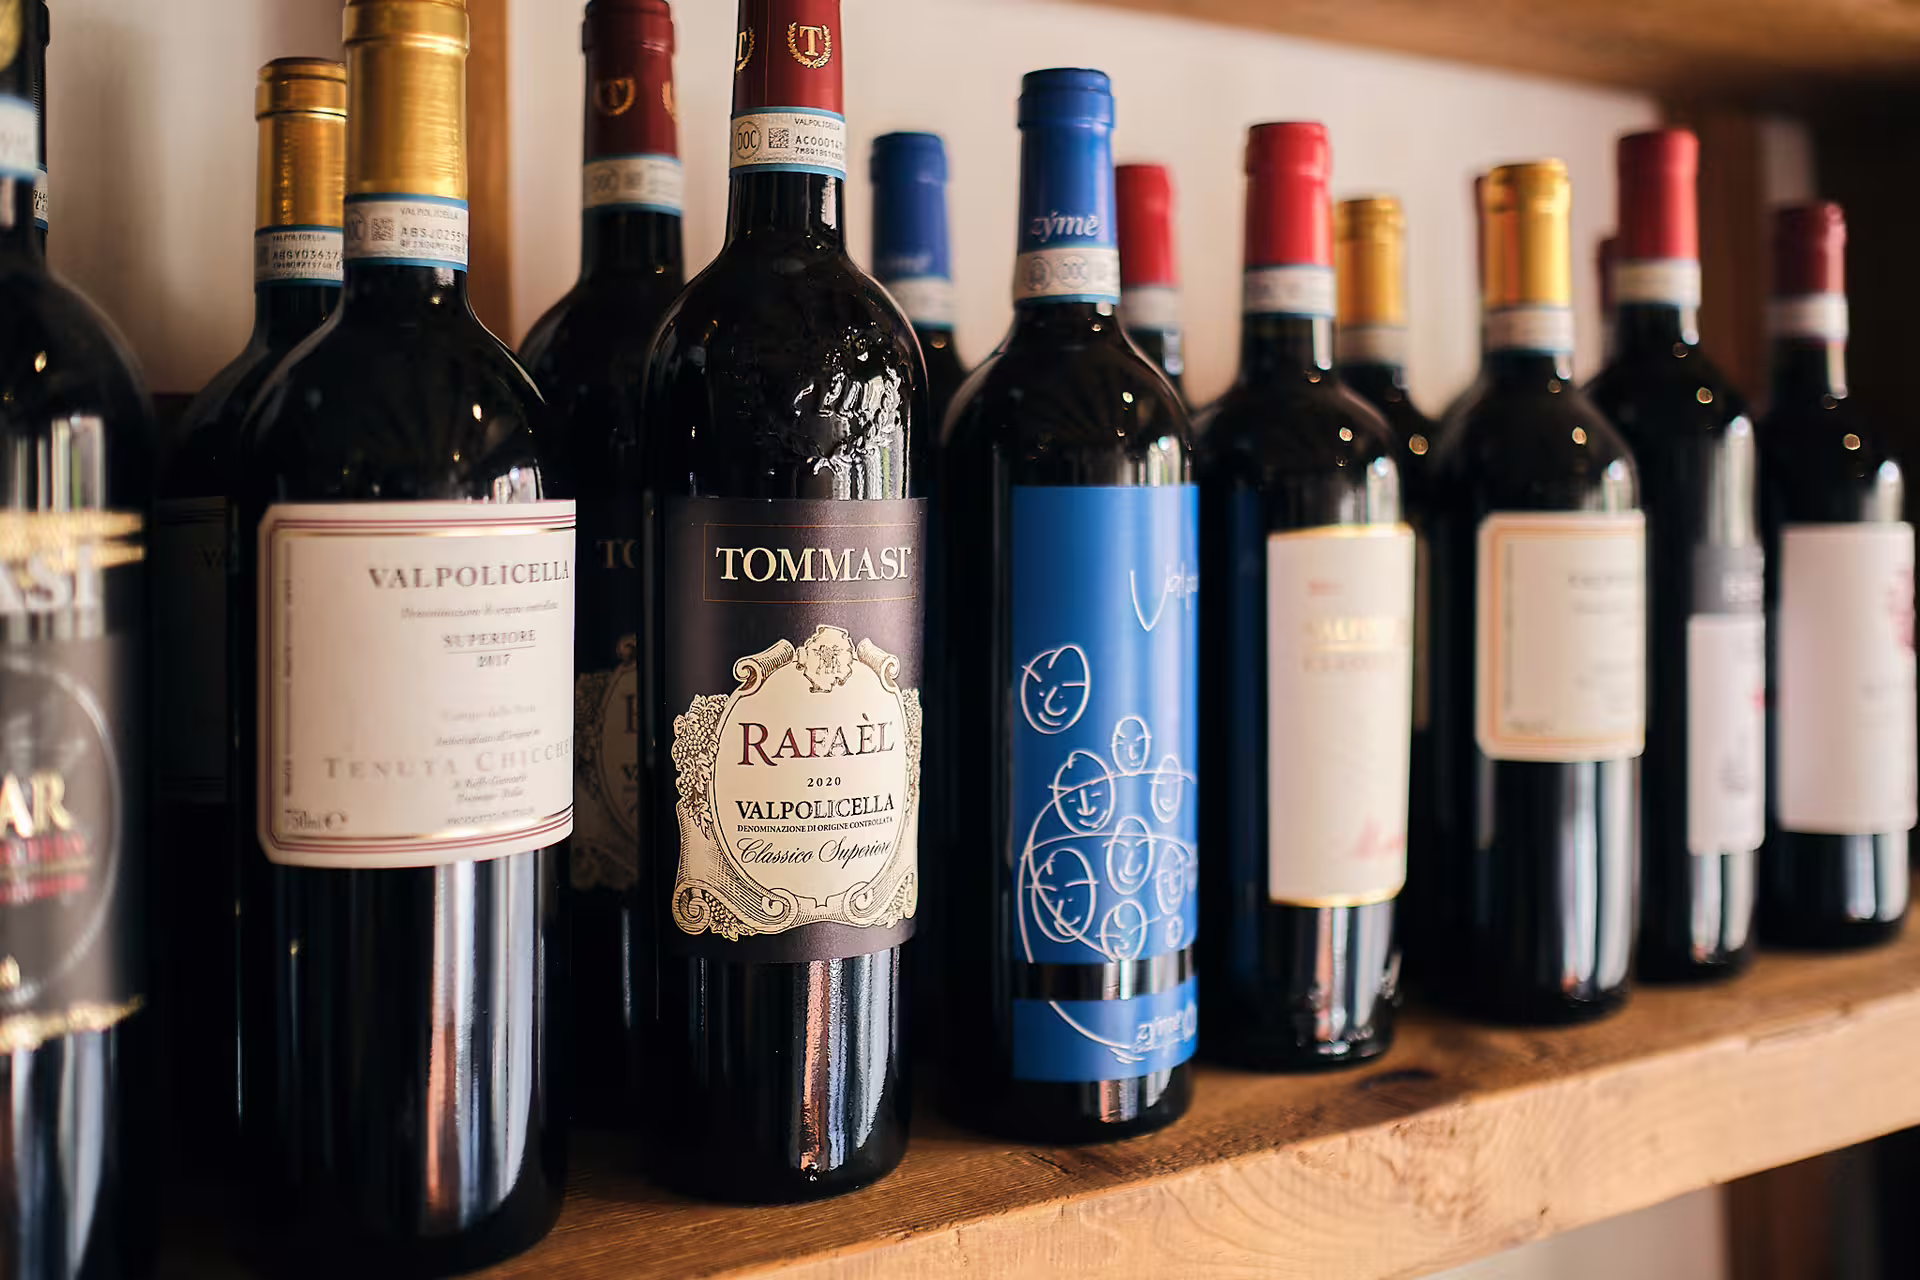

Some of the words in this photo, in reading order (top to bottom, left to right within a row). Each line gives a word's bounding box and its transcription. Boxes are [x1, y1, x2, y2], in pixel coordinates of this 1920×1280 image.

[799, 25, 823, 57] T
[738, 130, 757, 150] DOC
[368, 560, 571, 589] VALPOLICELLA
[716, 545, 913, 583] TOMMASI
[443, 630, 536, 647] SUPERIORE
[738, 713, 895, 767] RAFAÈL
[323, 756, 458, 779] TENUTA
[806, 777, 841, 788] 2020
[736, 793, 895, 822] VALPOLICELLA
[737, 823, 806, 834] DENOMINAZIONE
[807, 824, 818, 833] DI
[819, 823, 848, 832] ORIGINE
[849, 816, 893, 831] CONTROLLATA
[737, 837, 815, 867] Classico
[819, 838, 892, 869] Superiore
